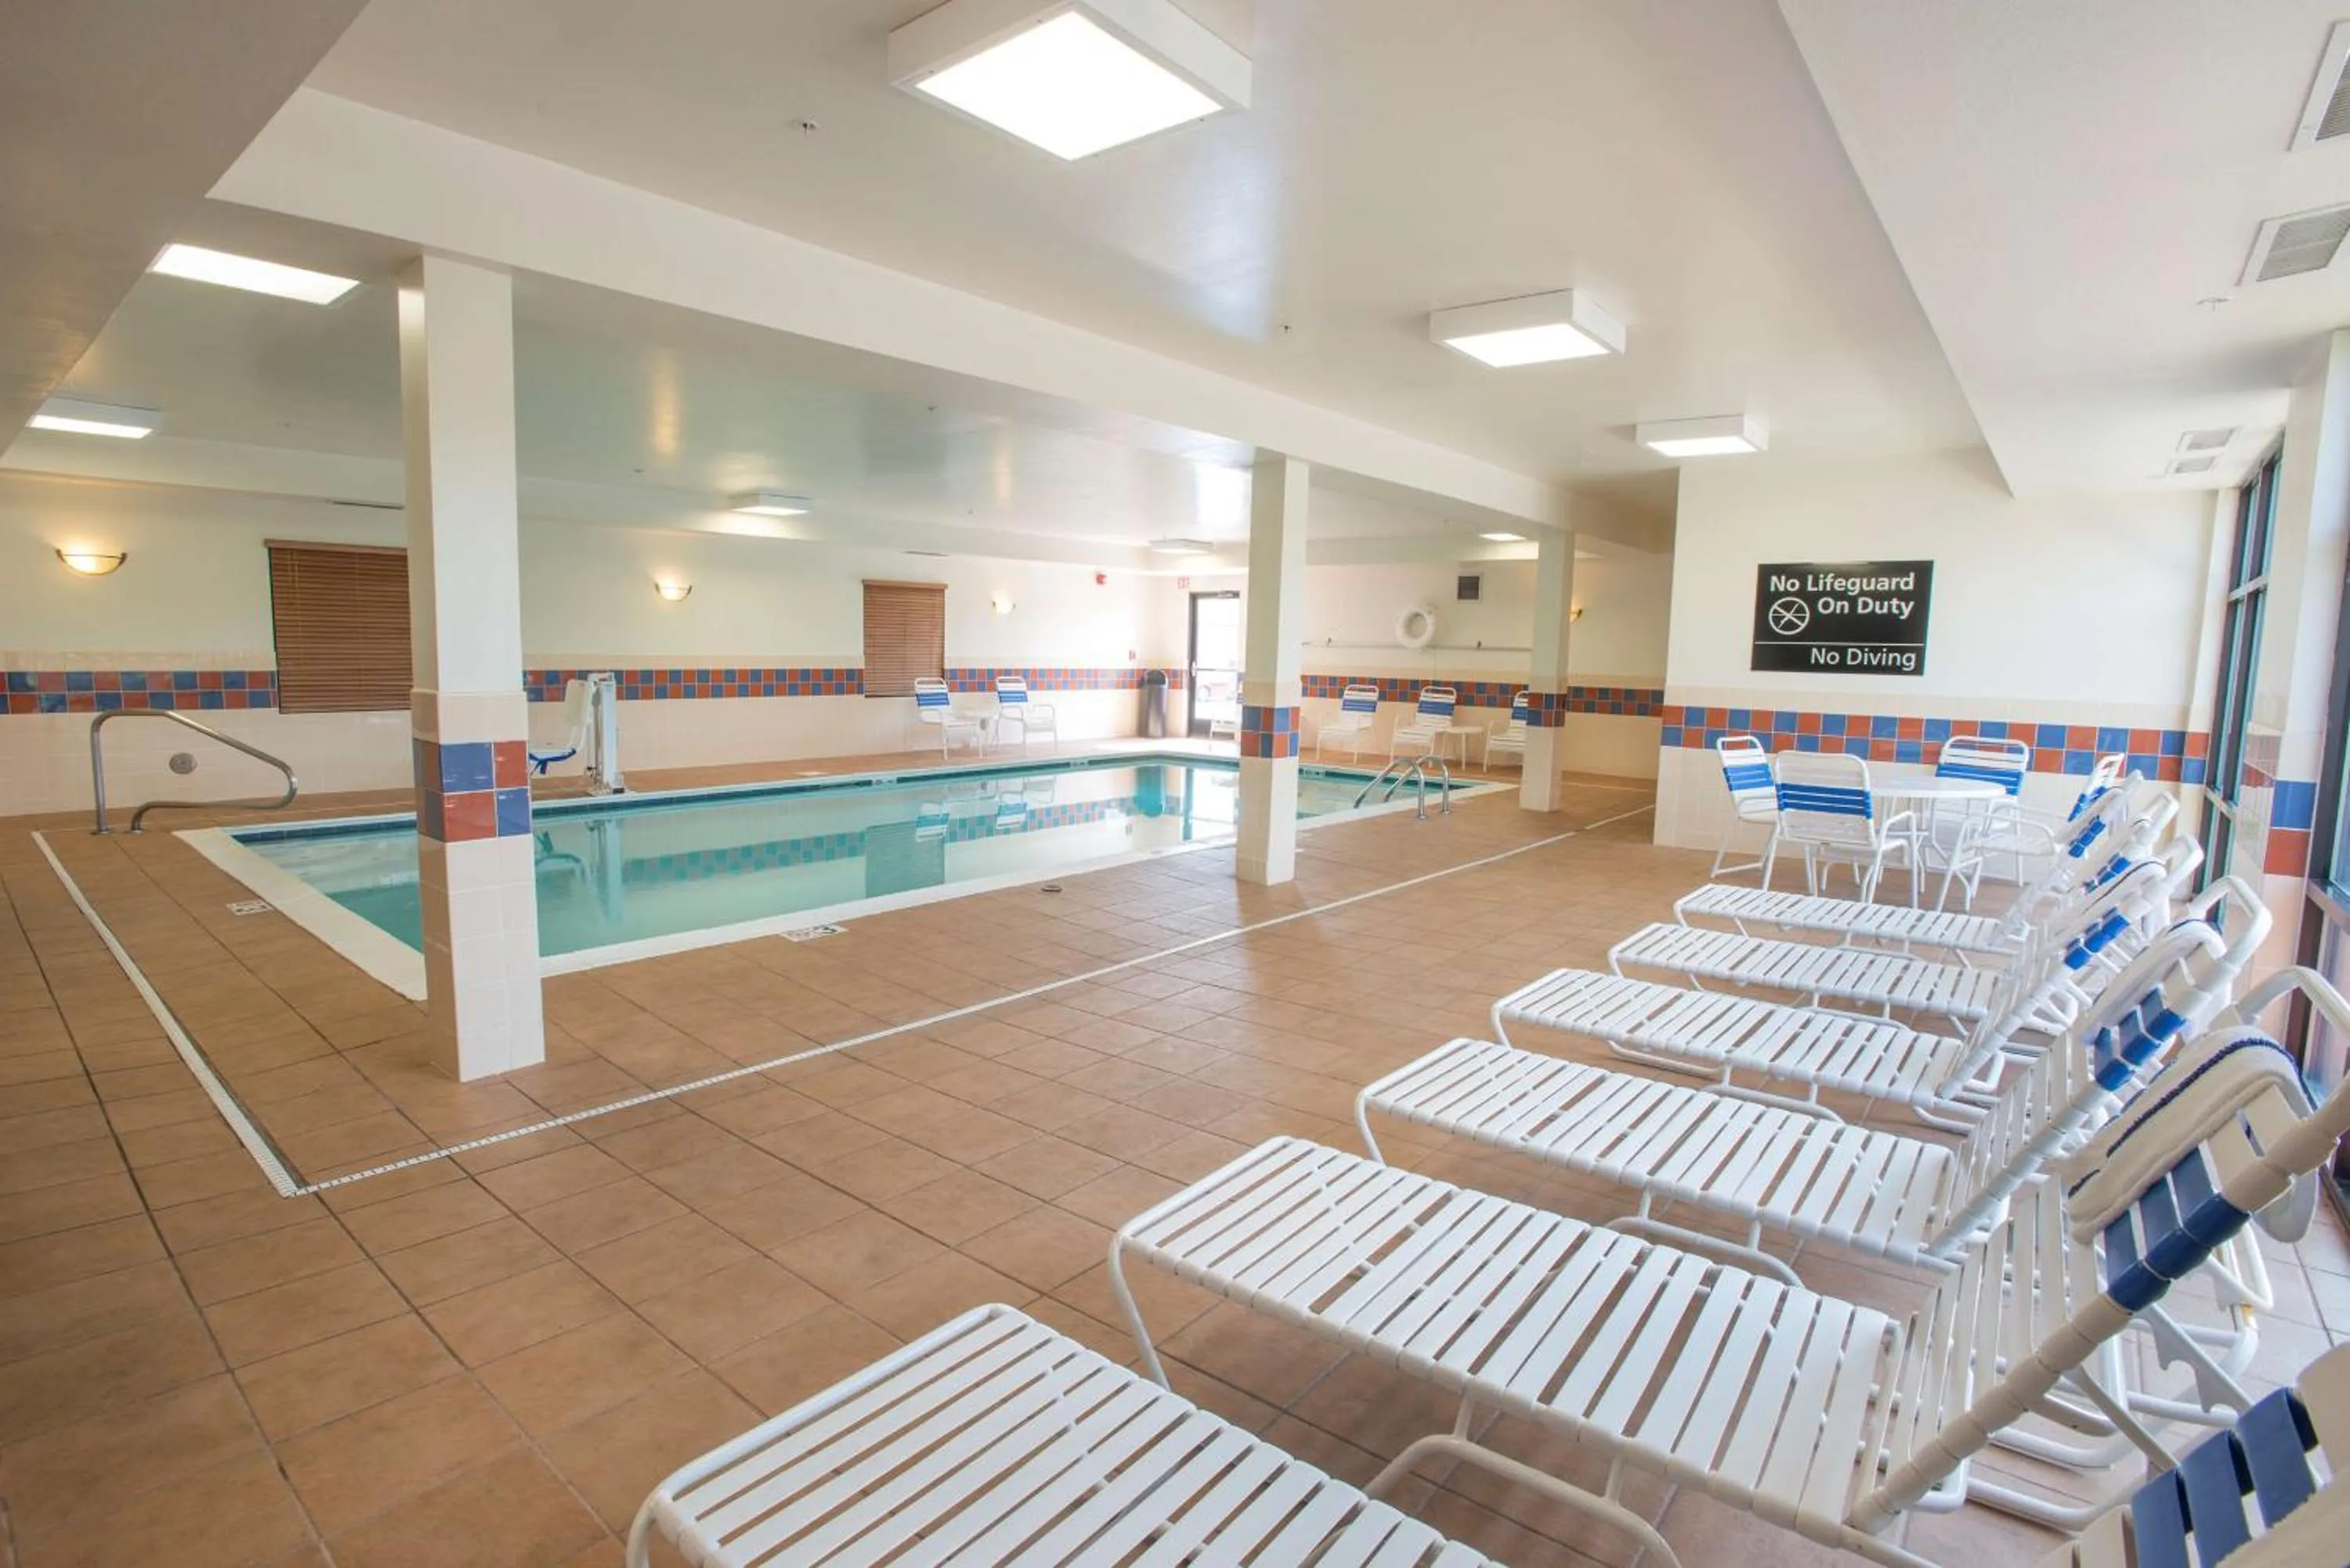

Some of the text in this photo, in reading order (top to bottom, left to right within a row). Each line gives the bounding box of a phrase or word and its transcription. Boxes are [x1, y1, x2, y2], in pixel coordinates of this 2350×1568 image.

[1770, 573, 1915, 595] No Lifeguard
[1817, 597, 1915, 619] On Duty
[1810, 648, 1916, 671] No Diving
